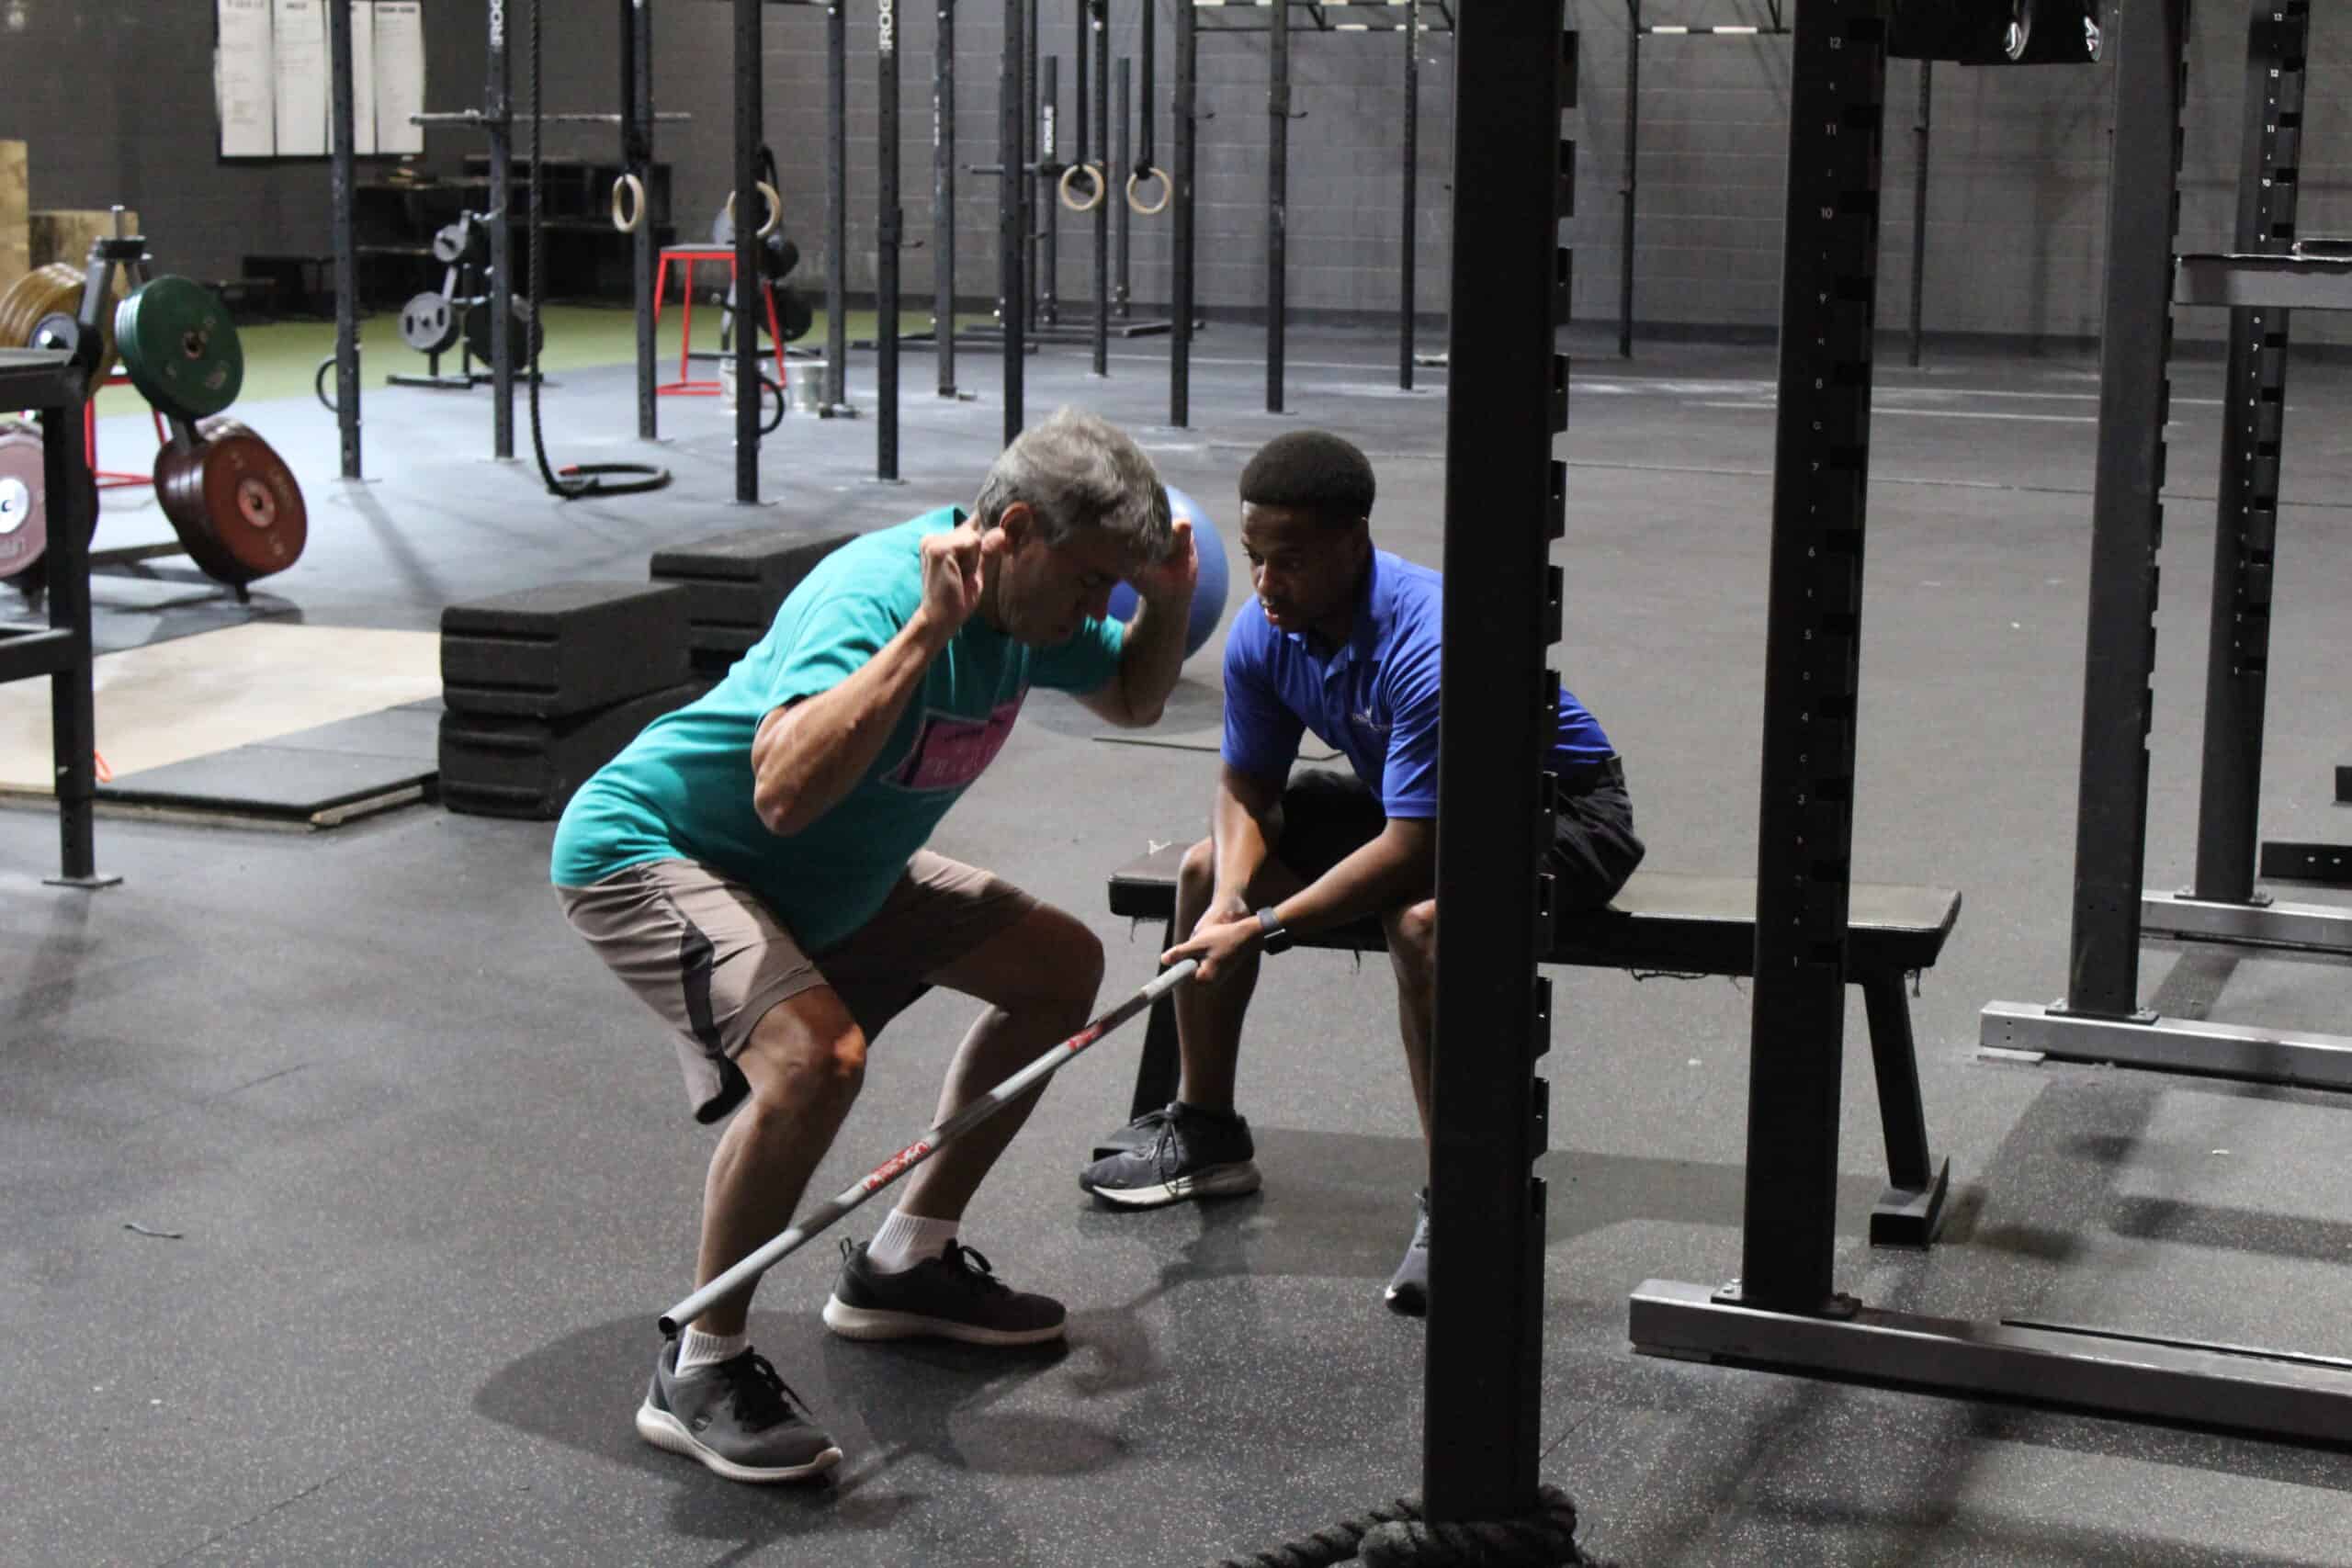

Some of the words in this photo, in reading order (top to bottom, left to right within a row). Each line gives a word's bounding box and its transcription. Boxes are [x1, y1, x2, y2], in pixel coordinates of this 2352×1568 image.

[1829, 36, 1842, 50] 12
[1826, 124, 1838, 135] 11
[2267, 124, 2275, 133] 11
[1821, 207, 1834, 220] 10
[1815, 378, 1824, 389] 8
[1807, 547, 1816, 558] 6
[1801, 712, 1809, 723] 4
